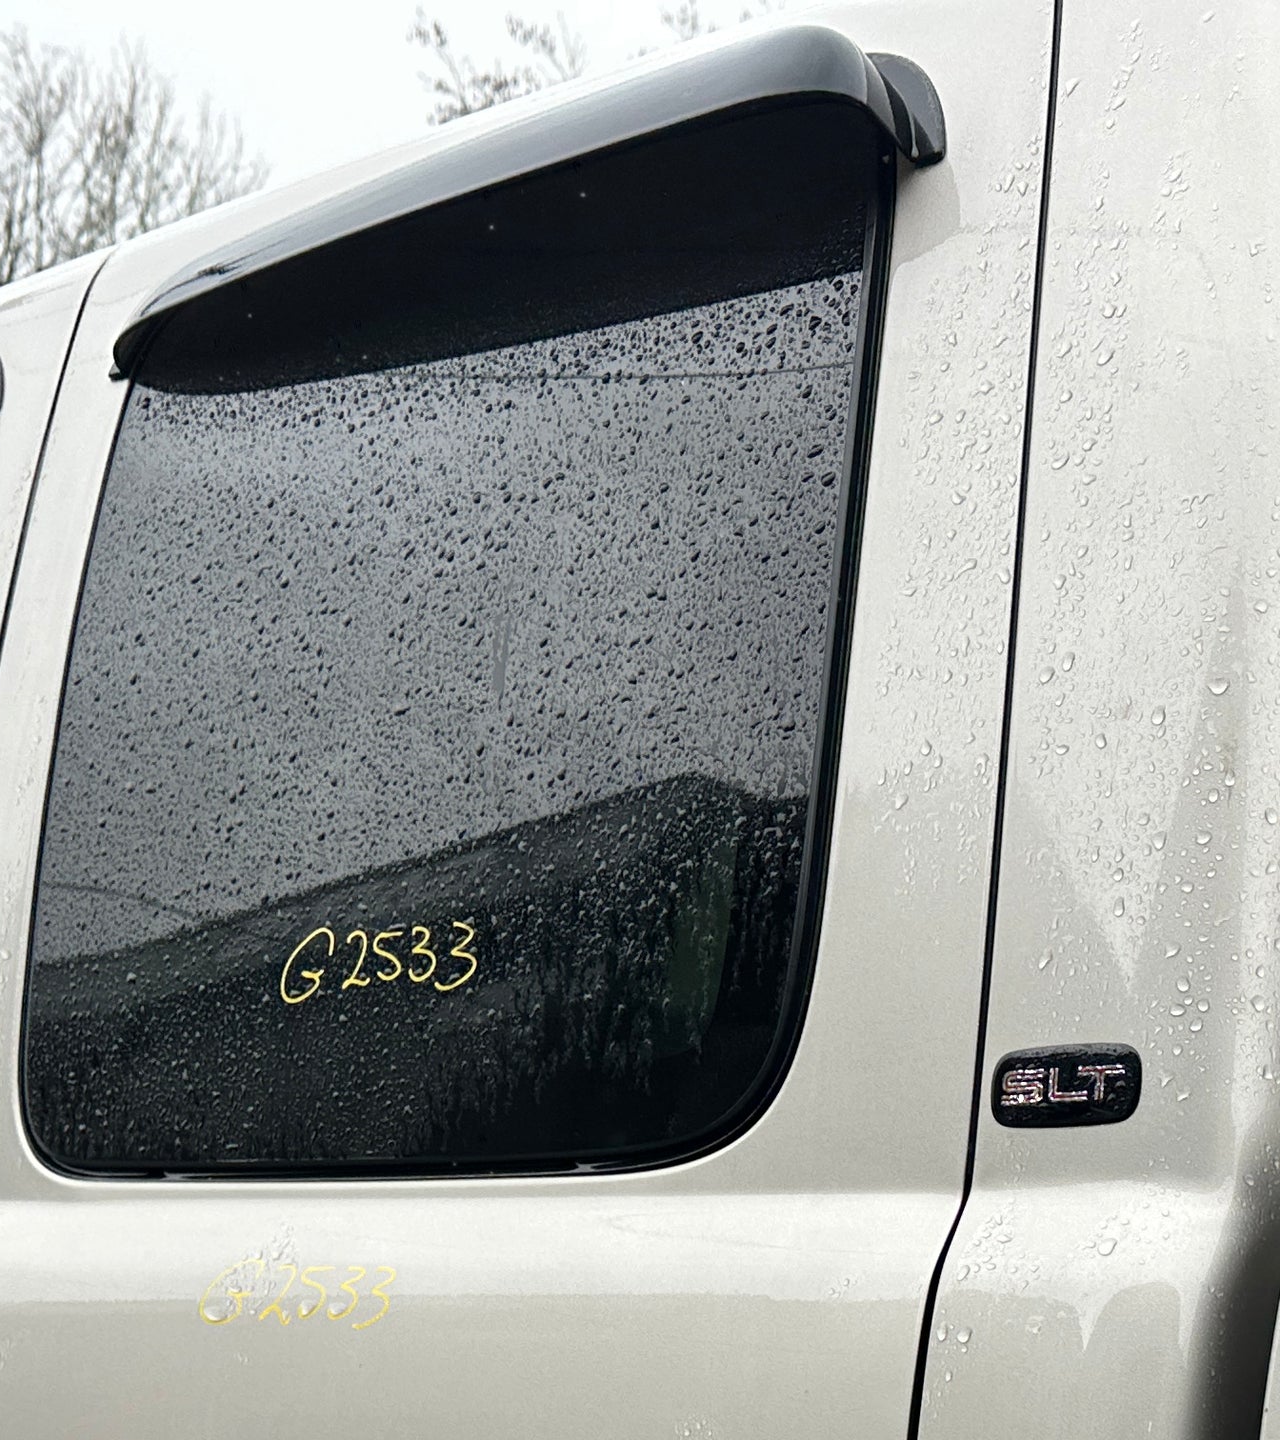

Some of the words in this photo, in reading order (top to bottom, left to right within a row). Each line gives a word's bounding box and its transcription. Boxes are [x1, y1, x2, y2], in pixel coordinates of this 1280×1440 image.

[280, 921, 478, 1003] G2533
[1001, 1063, 1125, 1106] SLT
[198, 1259, 397, 1330] G2533
